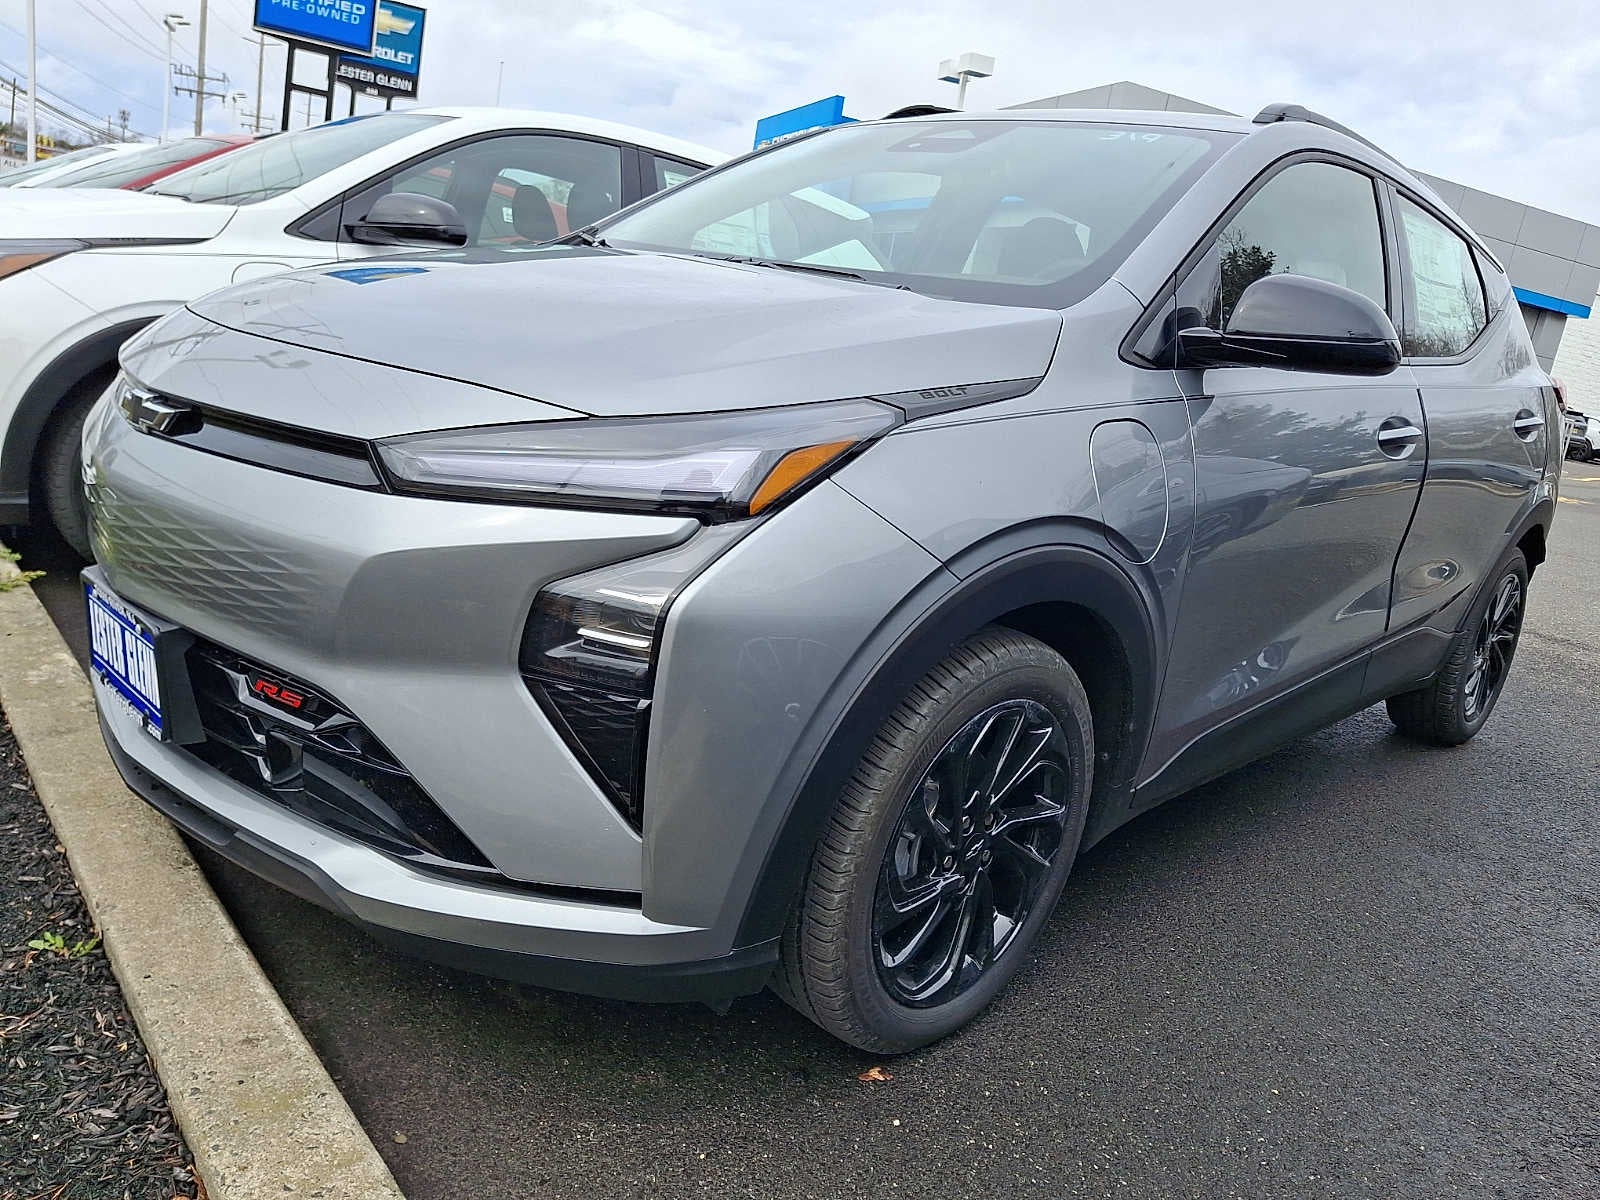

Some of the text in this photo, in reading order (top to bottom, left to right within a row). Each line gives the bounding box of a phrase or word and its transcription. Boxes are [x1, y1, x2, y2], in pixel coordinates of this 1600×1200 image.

[373, 46, 414, 64] ROLET
[335, 64, 375, 83] LESTER
[375, 72, 413, 92] GLENN
[920, 388, 968, 399] BOLT
[254, 680, 302, 708] RS
